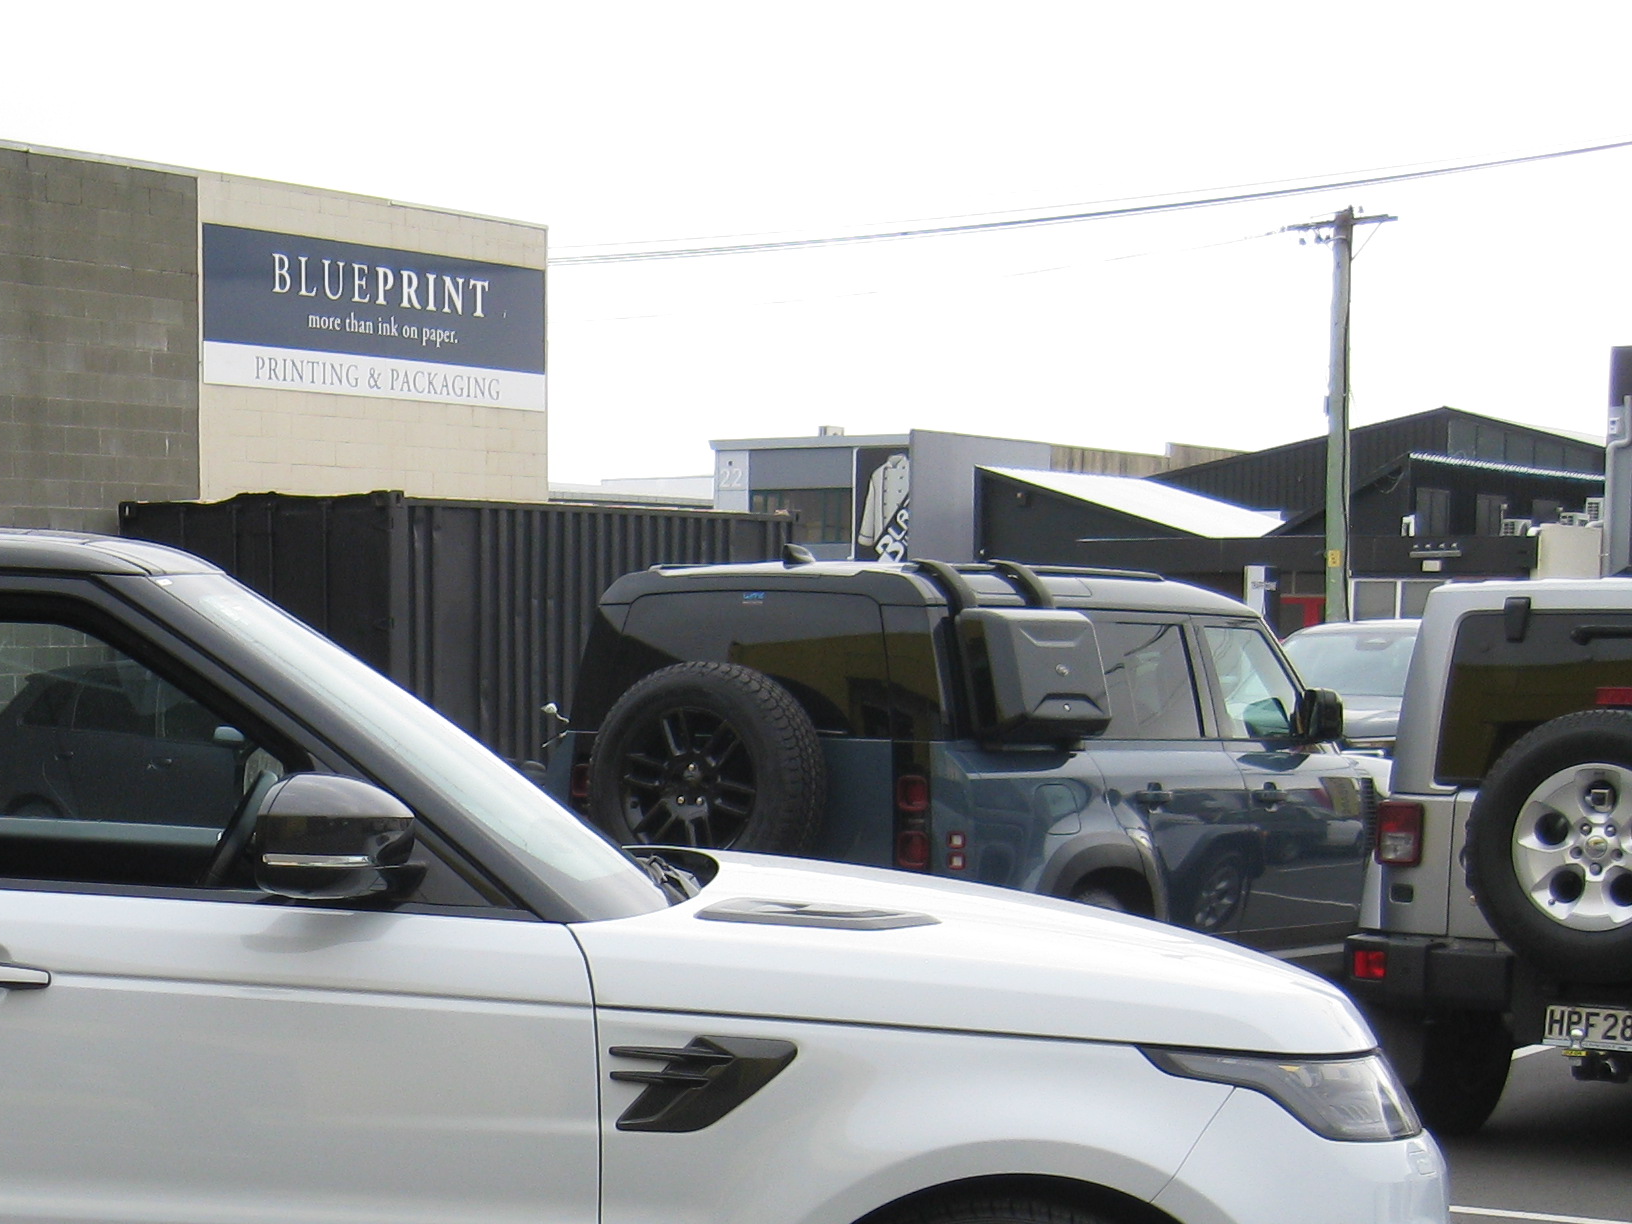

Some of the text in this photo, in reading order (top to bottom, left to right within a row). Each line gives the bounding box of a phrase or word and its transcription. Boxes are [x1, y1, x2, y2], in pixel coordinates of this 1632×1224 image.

[271, 252, 490, 318] BLUEPRINT
[308, 311, 458, 348] more than ink on paper.
[254, 355, 501, 401] PRINTING & PACKAGING
[719, 468, 743, 488] 22
